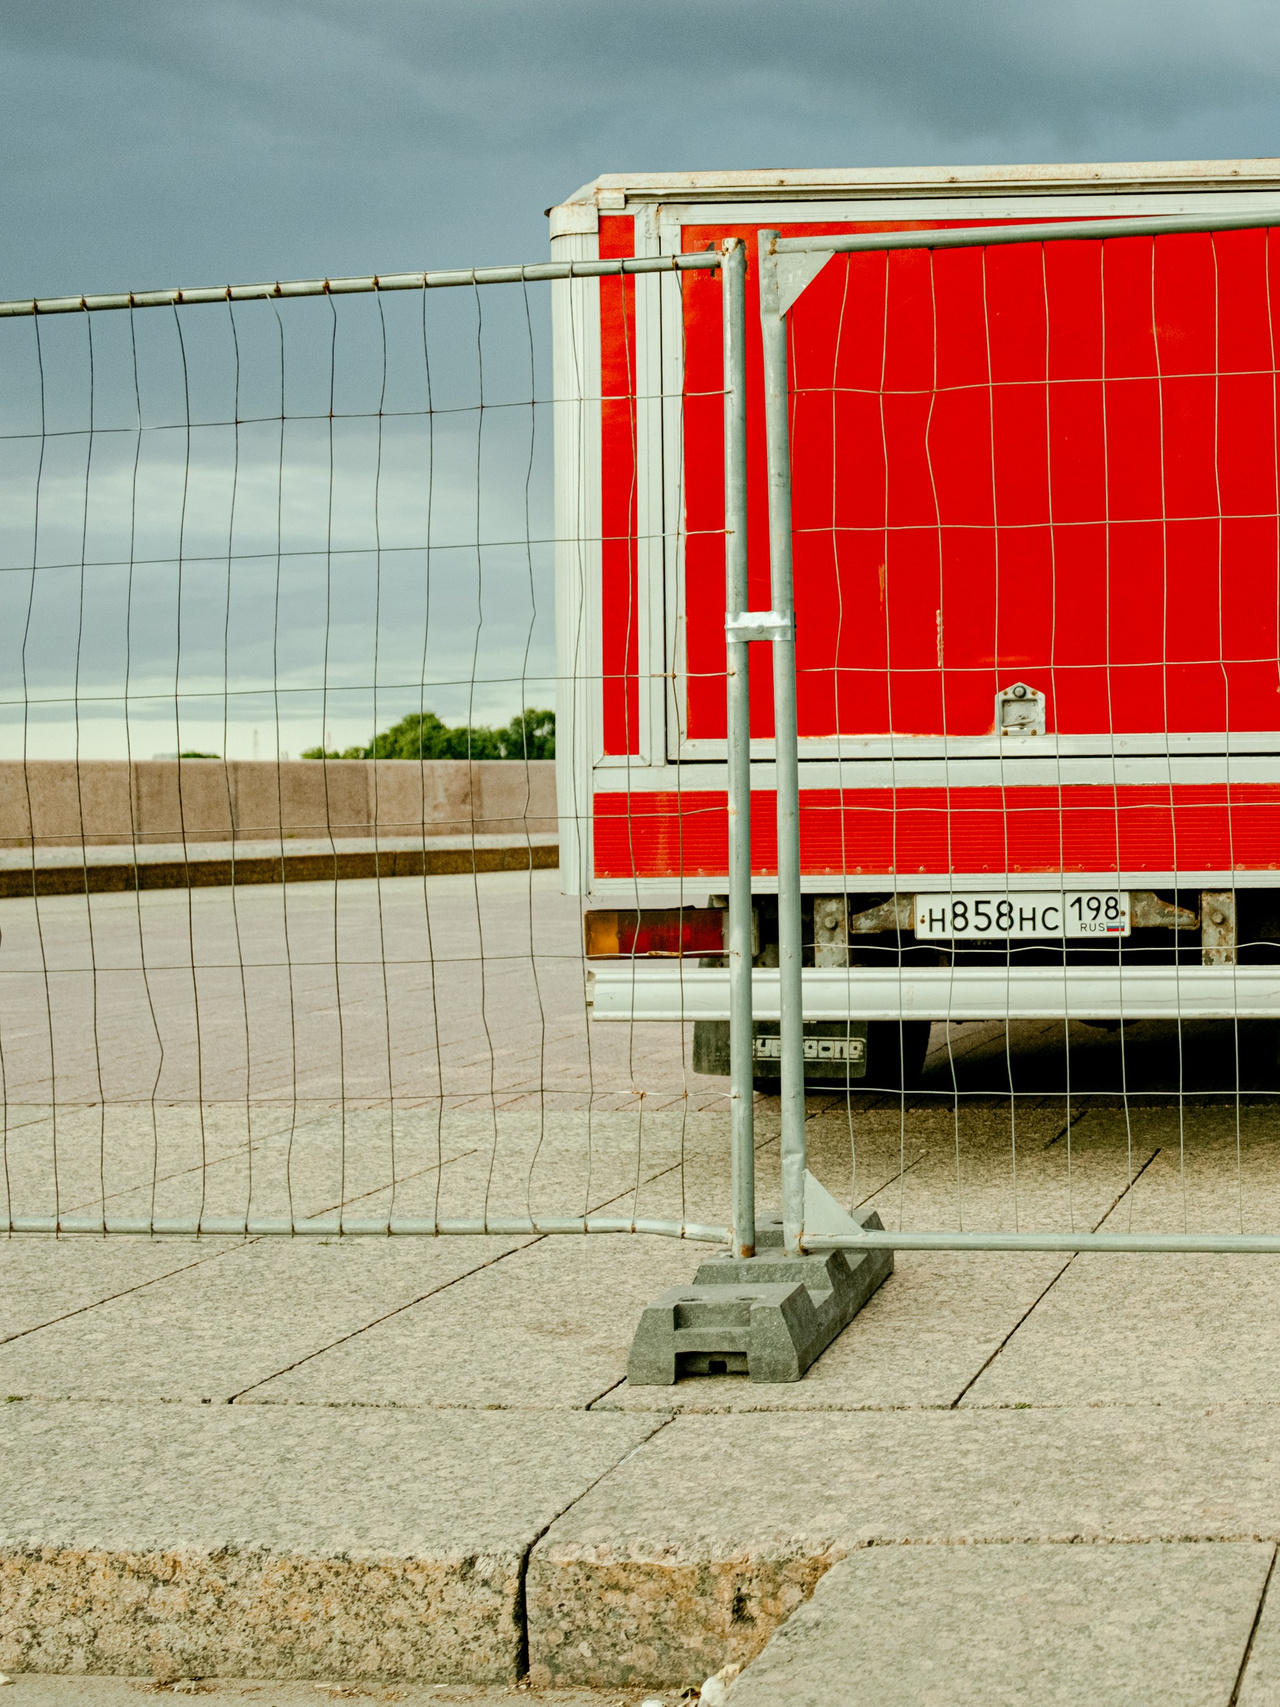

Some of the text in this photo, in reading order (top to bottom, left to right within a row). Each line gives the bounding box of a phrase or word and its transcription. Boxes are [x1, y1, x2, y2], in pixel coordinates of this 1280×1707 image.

[928, 896, 1119, 933] Н858НС 198
[1080, 922, 1105, 932] RUS
